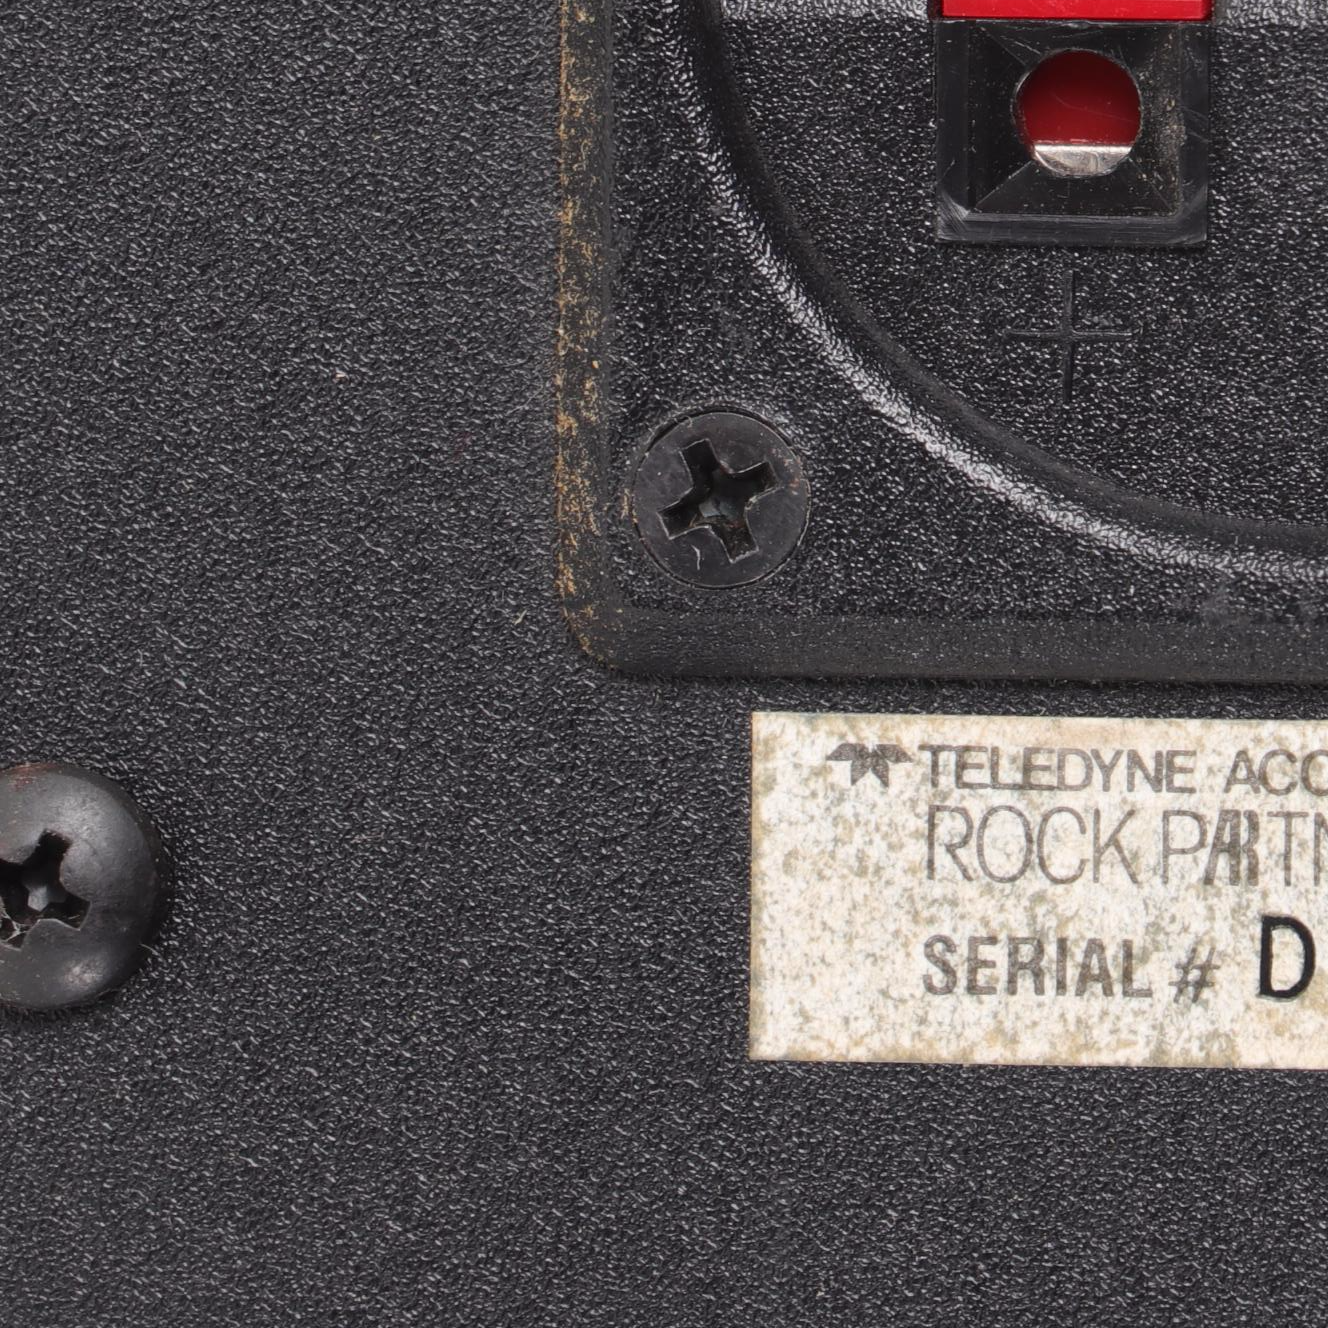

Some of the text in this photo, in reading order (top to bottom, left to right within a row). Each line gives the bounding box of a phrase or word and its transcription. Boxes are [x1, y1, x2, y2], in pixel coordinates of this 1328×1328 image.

[918, 743, 1197, 794] TELEDYNE
[926, 804, 1141, 886] ROCK
[922, 933, 1153, 999] SERIAL
